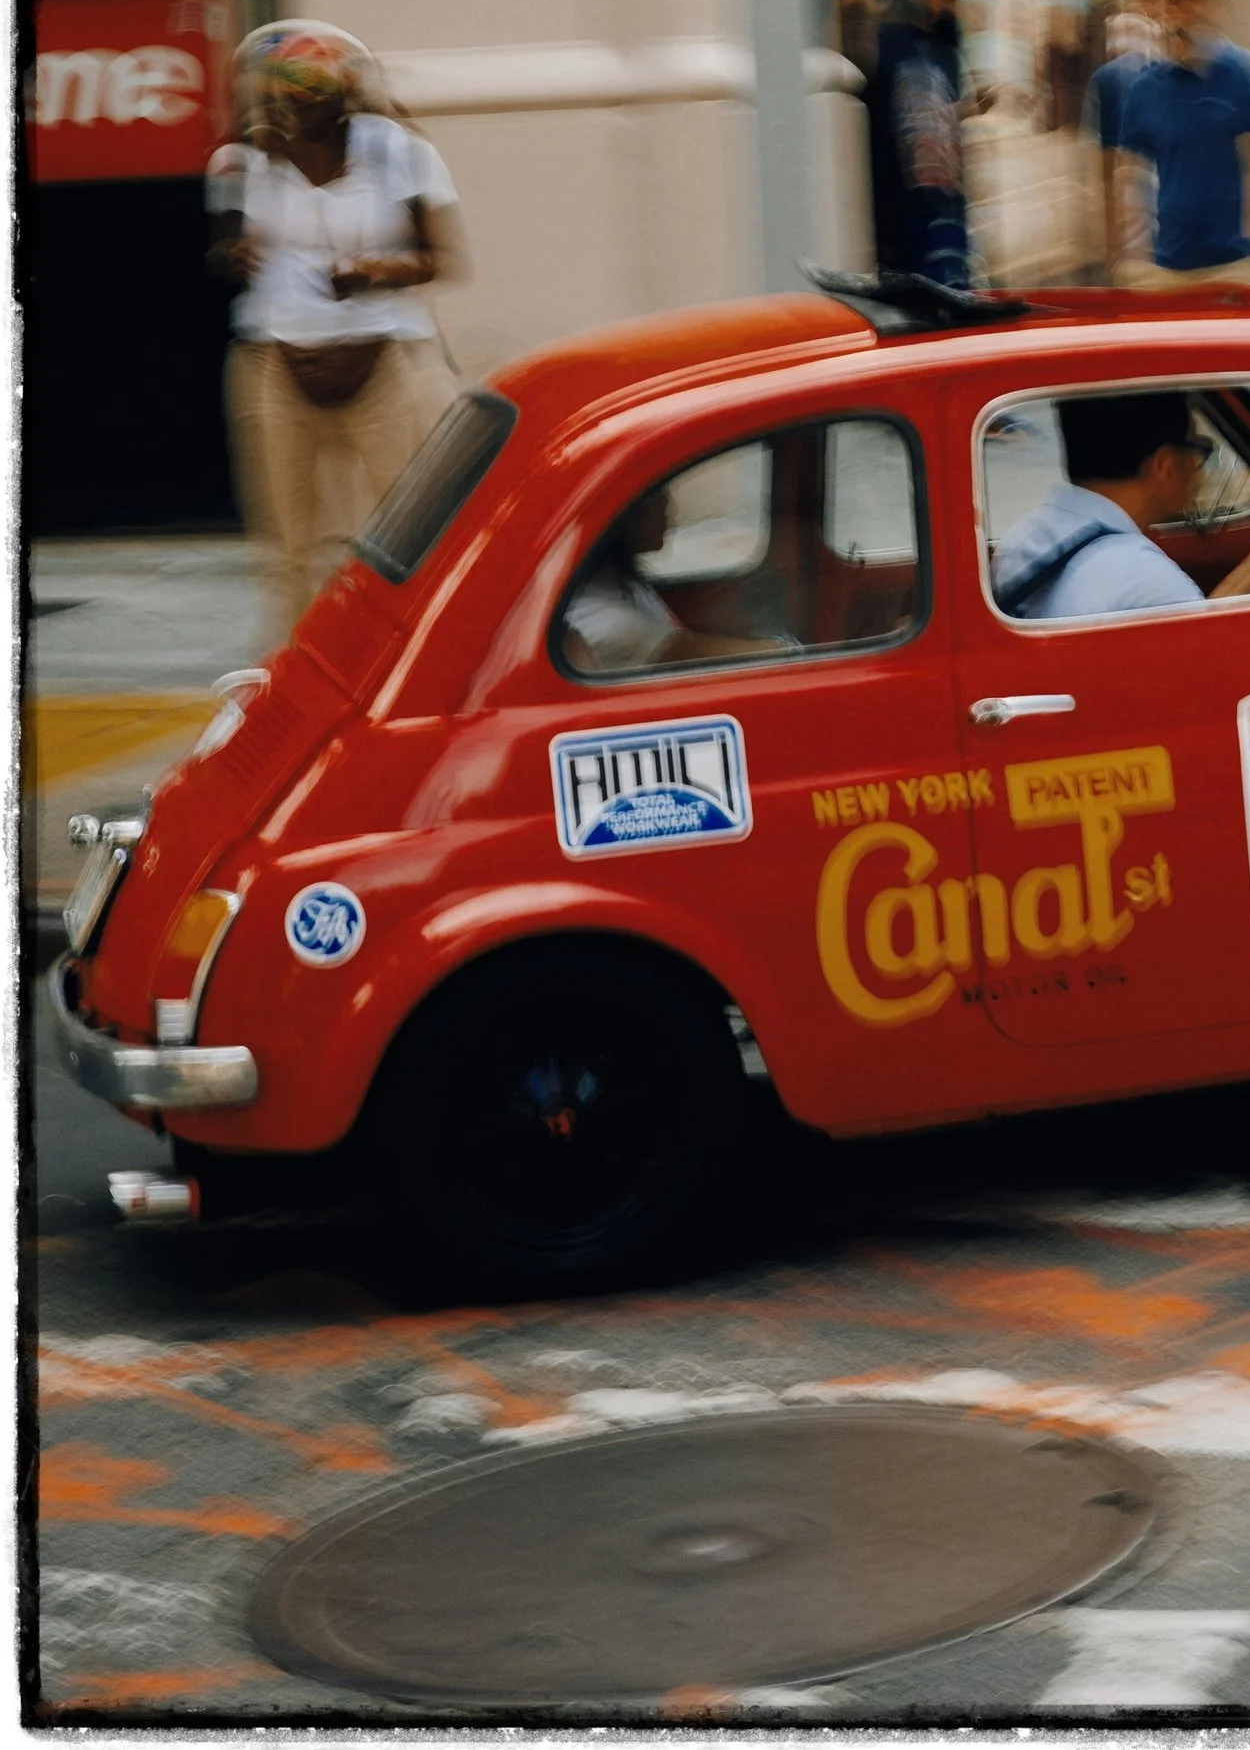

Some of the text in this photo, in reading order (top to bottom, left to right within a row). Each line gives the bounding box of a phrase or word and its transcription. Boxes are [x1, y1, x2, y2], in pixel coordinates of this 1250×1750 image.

[629, 792, 676, 810] TOTAL
[812, 768, 995, 828] NEW YORK
[1028, 761, 1154, 805] PATENT
